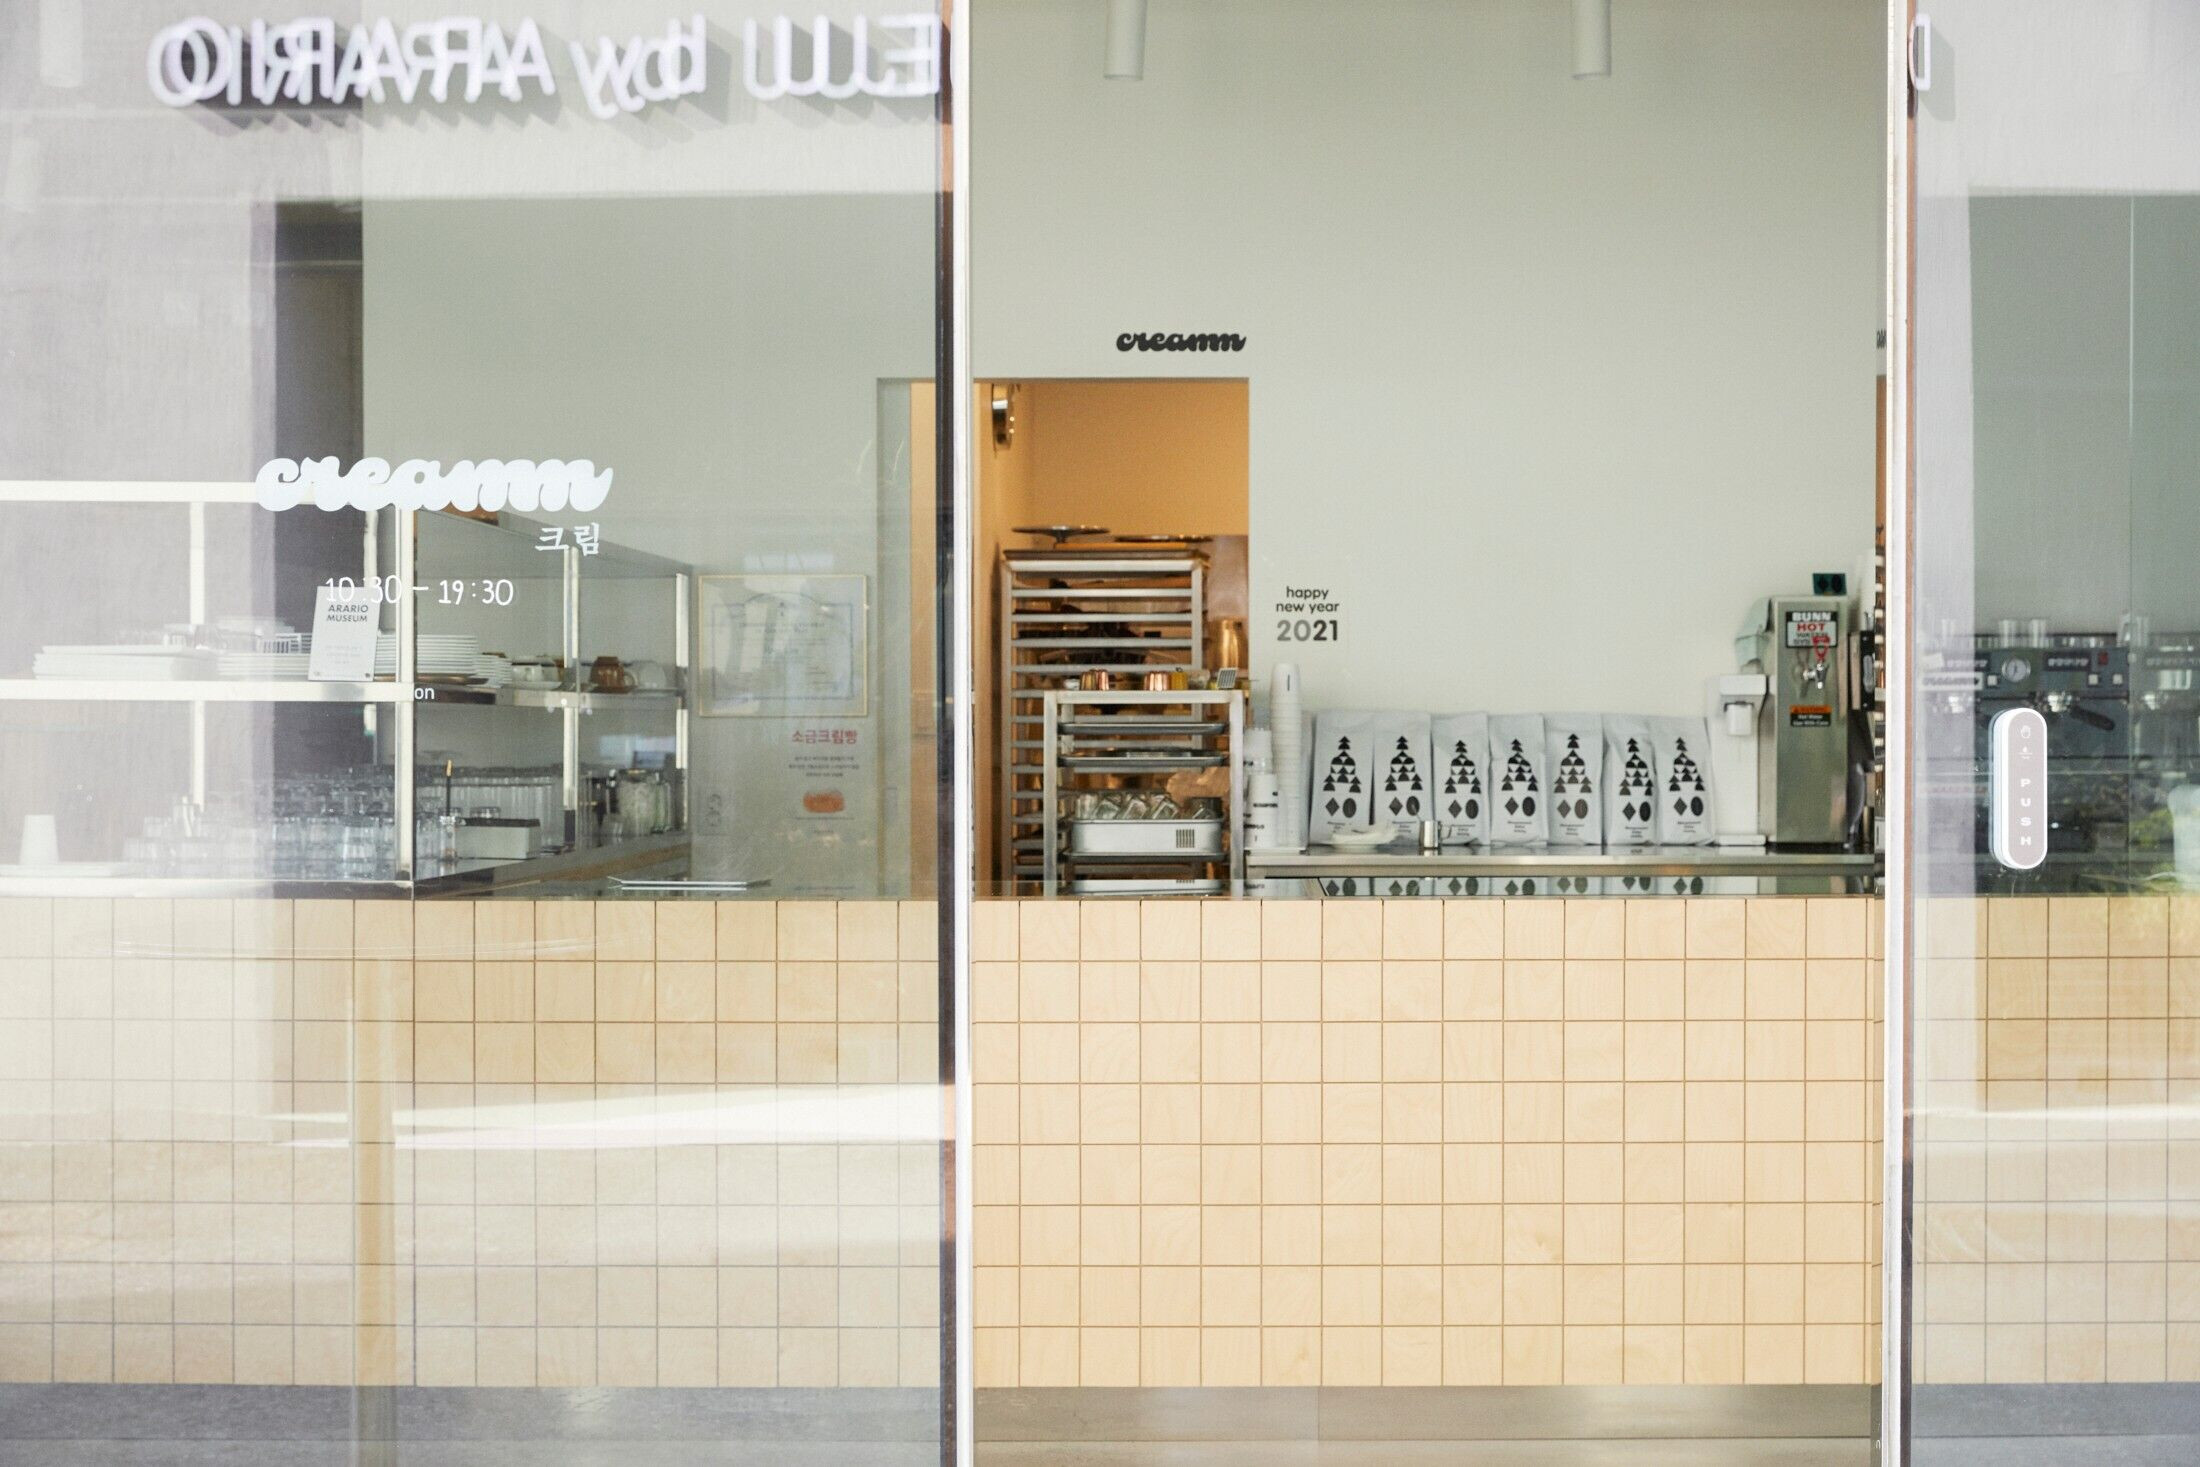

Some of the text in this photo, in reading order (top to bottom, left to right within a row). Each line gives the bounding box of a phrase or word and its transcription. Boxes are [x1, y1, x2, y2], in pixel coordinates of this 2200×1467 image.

[535, 522, 600, 556] 크림
[325, 575, 403, 604] 10:30
[438, 579, 514, 606] 19:30
[1286, 585, 1329, 600] happy
[328, 604, 369, 613] ARARIO
[1276, 602, 1339, 614] new year
[326, 614, 368, 623] MUSEUM
[1792, 612, 1831, 622] BUNN
[1276, 620, 1339, 642] 2021
[1797, 623, 1825, 631] HOT
[2020, 778, 2031, 846] PUSH
